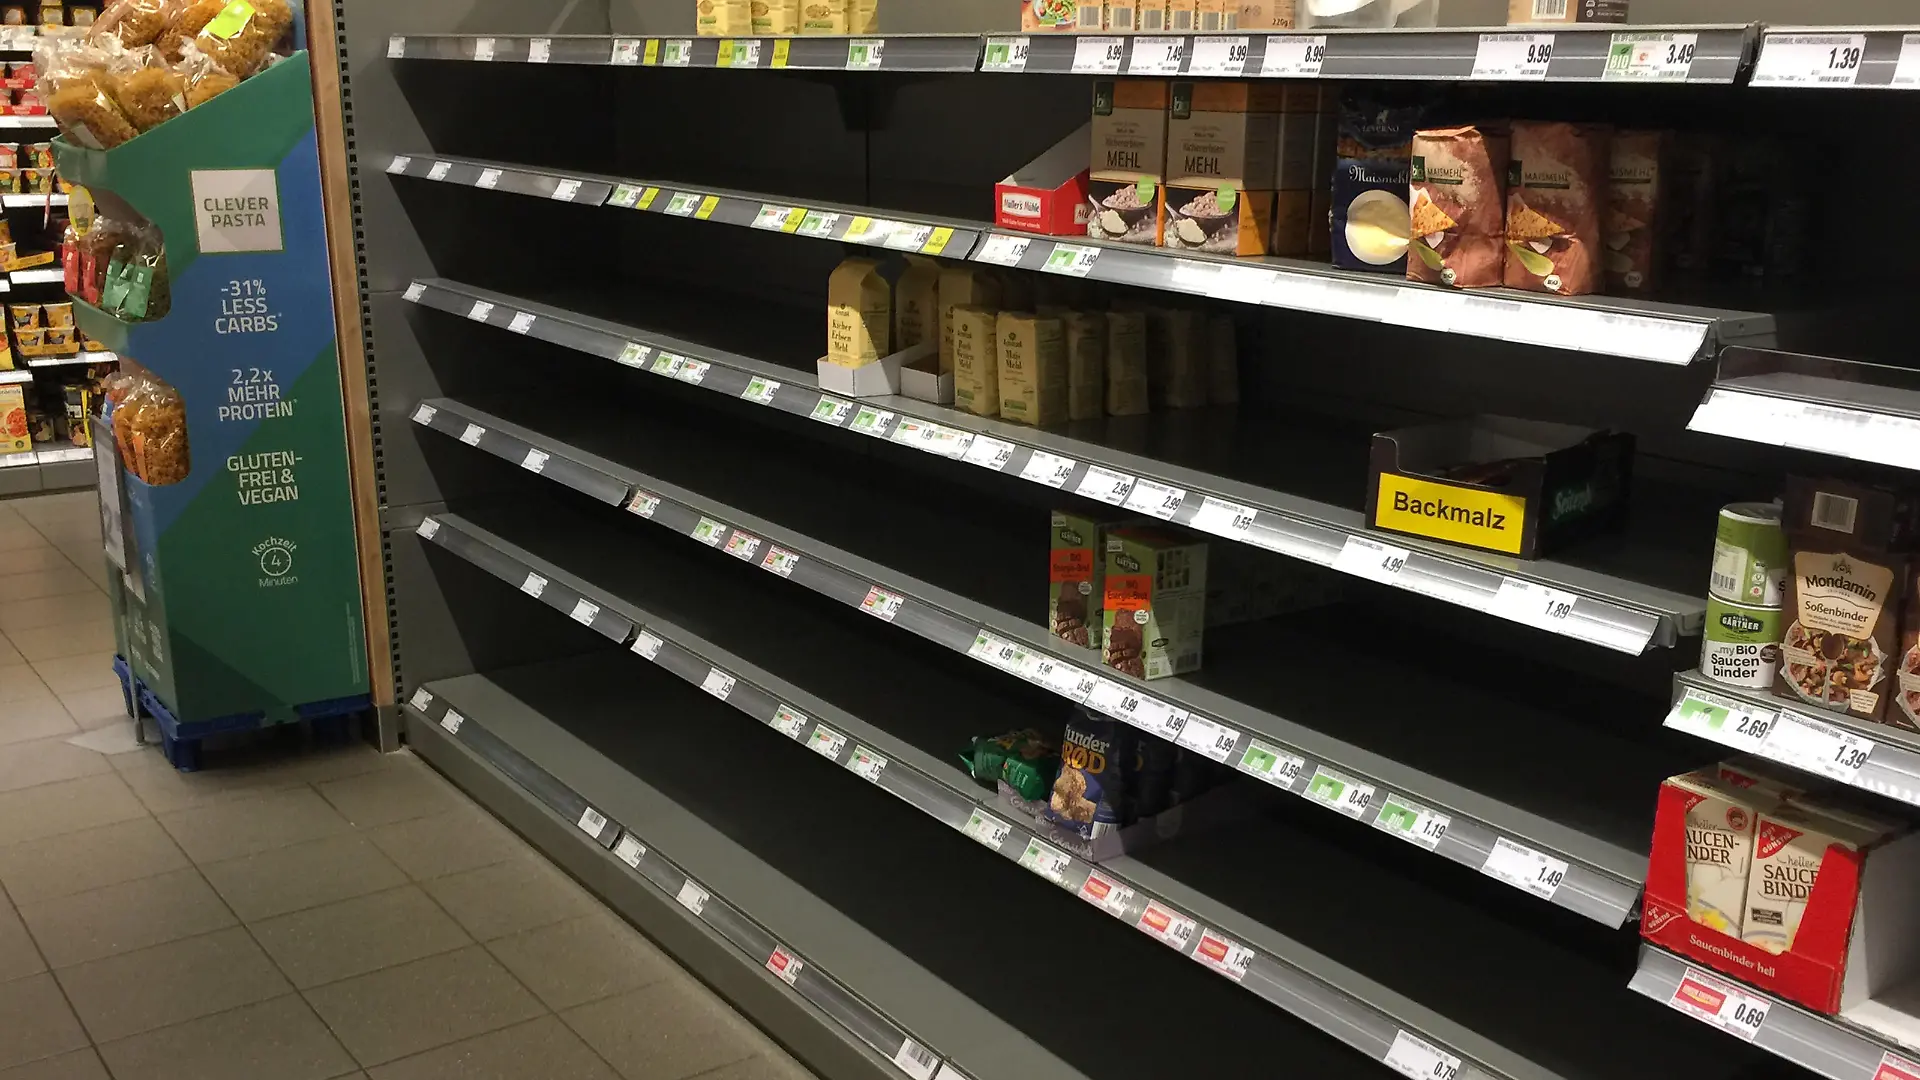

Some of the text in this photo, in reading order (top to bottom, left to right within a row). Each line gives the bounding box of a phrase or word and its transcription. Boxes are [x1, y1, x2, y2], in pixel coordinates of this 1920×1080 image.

[1106, 45, 1122, 61] 8.99
[1166, 45, 1182, 61] 7.49
[1228, 45, 1247, 62] 9.99
[1304, 45, 1325, 63] 8.99
[1527, 44, 1552, 64] 9.99
[1609, 54, 1630, 69] BIO
[1666, 43, 1695, 64] 3.49
[1828, 47, 1861, 69] 1.39
[1106, 150, 1141, 168] MEHL
[1184, 155, 1221, 175] MEHL
[1427, 167, 1464, 178] MAISMEHL
[203, 197, 269, 212] CLEVER
[211, 213, 266, 228] PASTA
[221, 279, 267, 297] -31%
[222, 297, 268, 315] LESS
[231, 368, 273, 386] 2,2x
[228, 384, 280, 403] MEHR
[226, 450, 303, 472] GLUTEN-
[239, 468, 295, 488] FREI &
[238, 485, 299, 506] VEGAN
[1112, 481, 1131, 496] 2.99
[1162, 494, 1181, 511] 2.99
[1393, 490, 1506, 531] Backmalz
[1231, 513, 1252, 531] 0.55
[251, 536, 298, 557] Kochzeit
[271, 554, 282, 567] 4
[1381, 555, 1404, 574] 4.99
[258, 575, 298, 588] Minuten
[1805, 574, 1877, 602] Mondamin
[1544, 599, 1571, 620] 1.89
[1804, 600, 1869, 623] Soßenbinder
[1721, 615, 1760, 631] GÄRTNER
[1711, 653, 1760, 667] Saucen
[1713, 665, 1758, 678] binder
[1120, 696, 1139, 712] 0.99
[1166, 714, 1185, 732] 0.99
[1736, 716, 1768, 739] 2.69
[1064, 724, 1110, 753] under
[1216, 735, 1235, 753] 0.99
[1834, 744, 1868, 770] 1.39
[1280, 761, 1300, 779] 0.59
[1348, 789, 1371, 809] 0.49
[1422, 819, 1446, 840] 1.19
[1685, 828, 1740, 849] AUCEN-
[1537, 866, 1563, 888] 1.49
[1173, 923, 1192, 941] 0.89
[1232, 952, 1251, 969] 1.49
[1689, 934, 1776, 978] Saucenbinder hell
[1734, 1003, 1765, 1028] 0.69
[1433, 1061, 1457, 1080] 0.79
